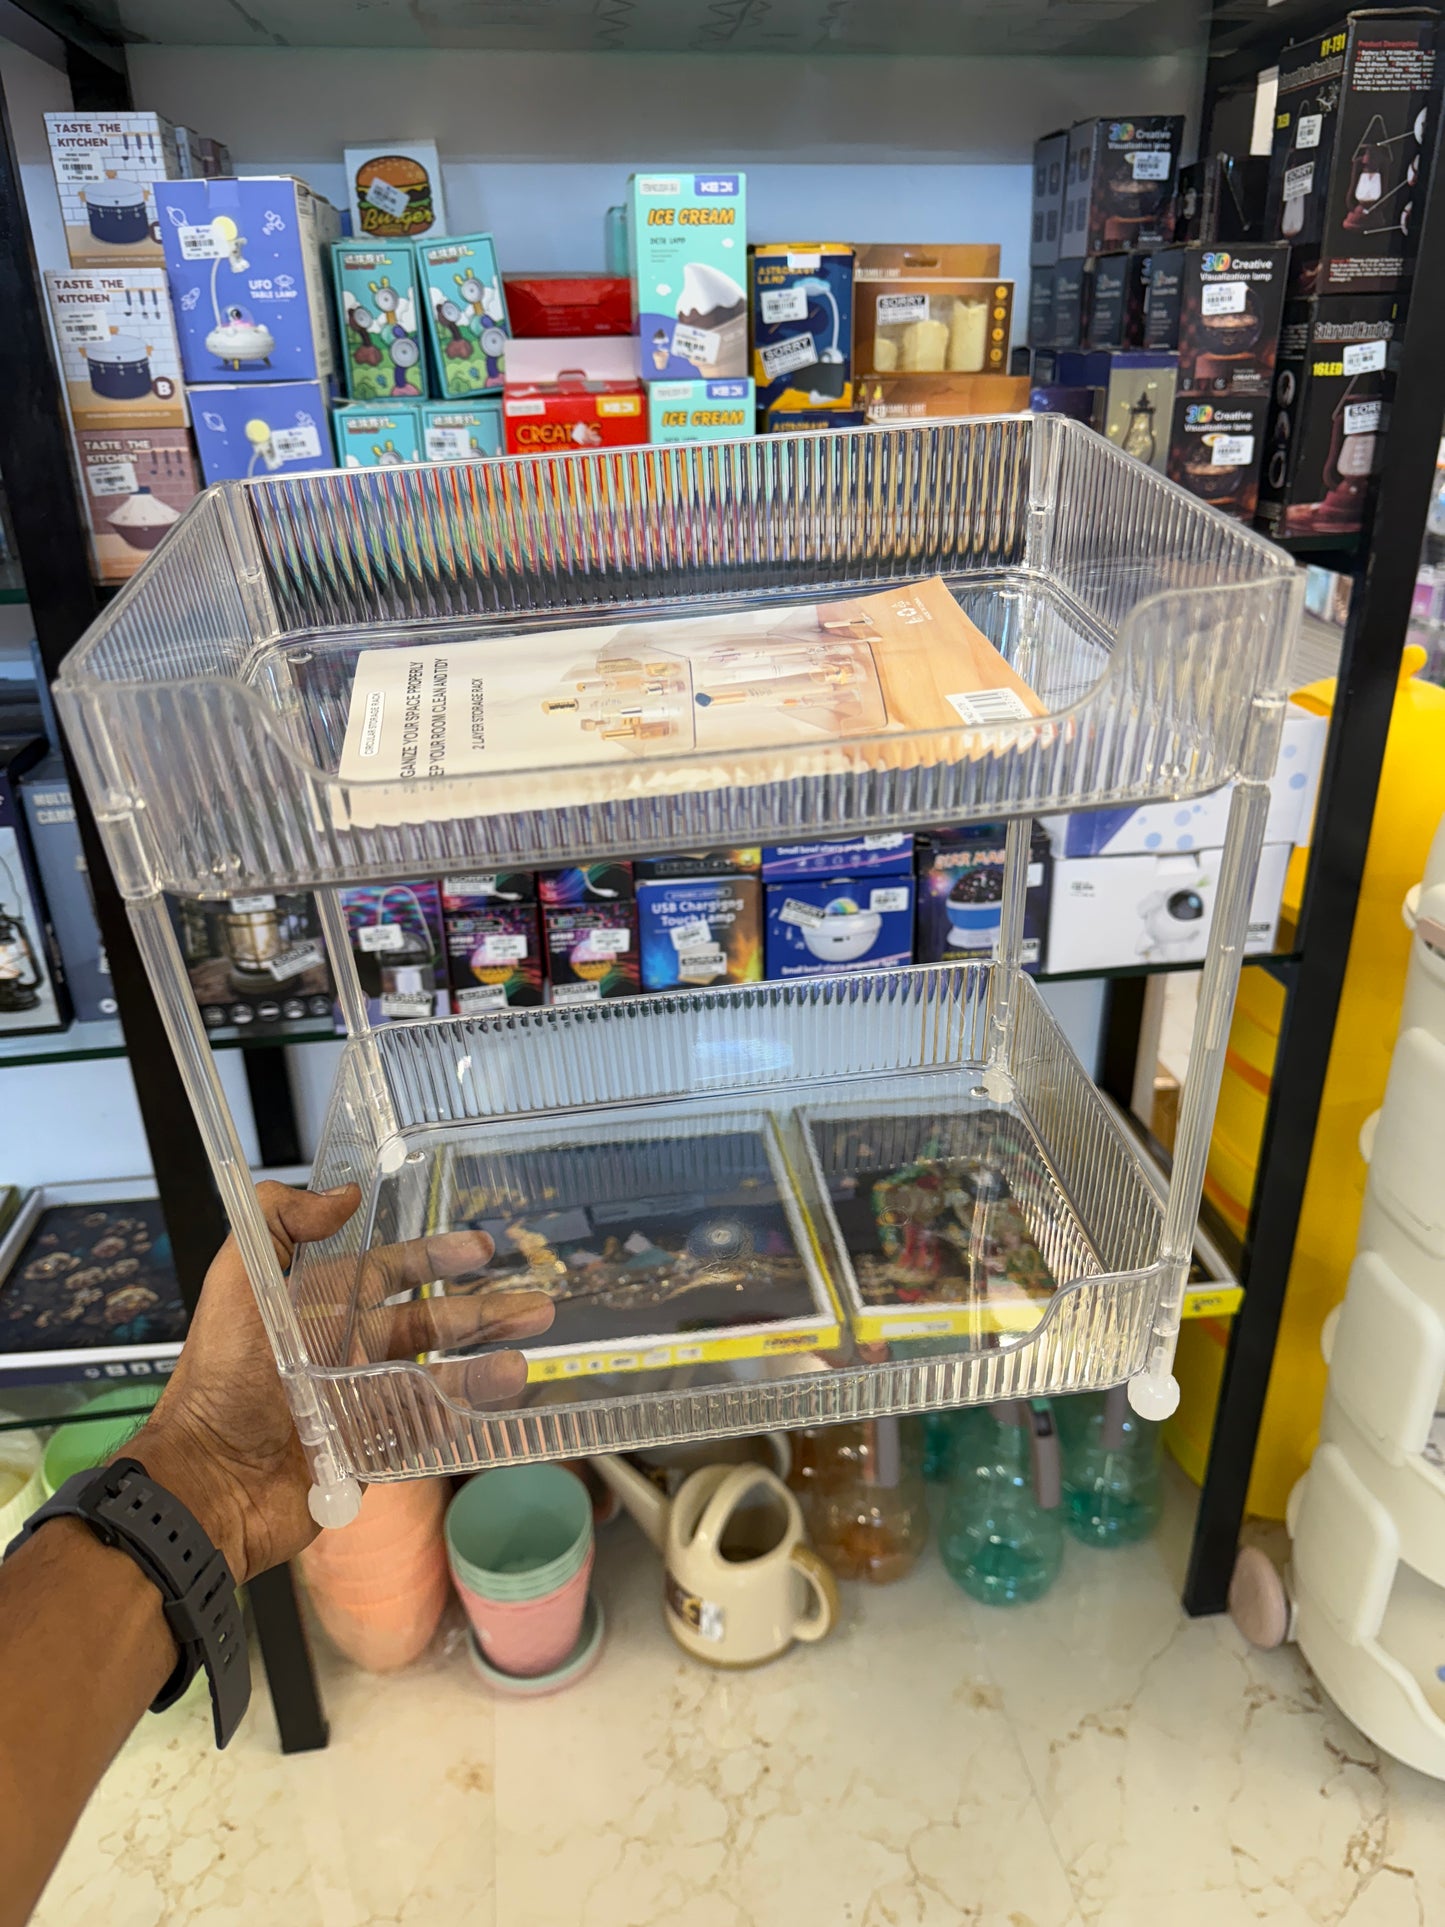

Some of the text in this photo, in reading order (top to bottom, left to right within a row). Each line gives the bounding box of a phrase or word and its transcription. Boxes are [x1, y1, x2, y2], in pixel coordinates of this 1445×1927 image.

[54, 123, 121, 133] TASTE THE
[1135, 129, 1171, 139] Creative
[57, 137, 109, 147] KITCHEN
[647, 208, 735, 226] ICE CREAM
[1201, 252, 1273, 272] 3D Creative
[54, 280, 125, 289] TASTE THE
[248, 279, 273, 290] UFO
[1200, 273, 1272, 282] Visualization lamp
[57, 294, 110, 304] KITCHEN
[878, 295, 926, 308] SORRY
[763, 338, 812, 361] SORRY
[156, 381, 171, 396] B
[661, 410, 744, 427] ICE CREAM
[1185, 404, 1254, 424] 3D Creative
[83, 440, 151, 451] TASTE THE
[86, 453, 138, 464] KITCHEN
[435, 658, 449, 674] TIDY
[407, 662, 423, 694] PROPERLY
[434, 673, 448, 687] AND
[472, 678, 483, 693] RACK
[371, 693, 380, 706] RACK
[432, 687, 447, 713] CLEAN
[405, 695, 421, 721] SPACE
[471, 693, 483, 723] STORAGE
[403, 720, 419, 745] YOUR
[431, 713, 446, 739] ROOM
[472, 723, 484, 743] LAYER
[430, 738, 445, 763] YOUR
[651, 902, 677, 914] USB
